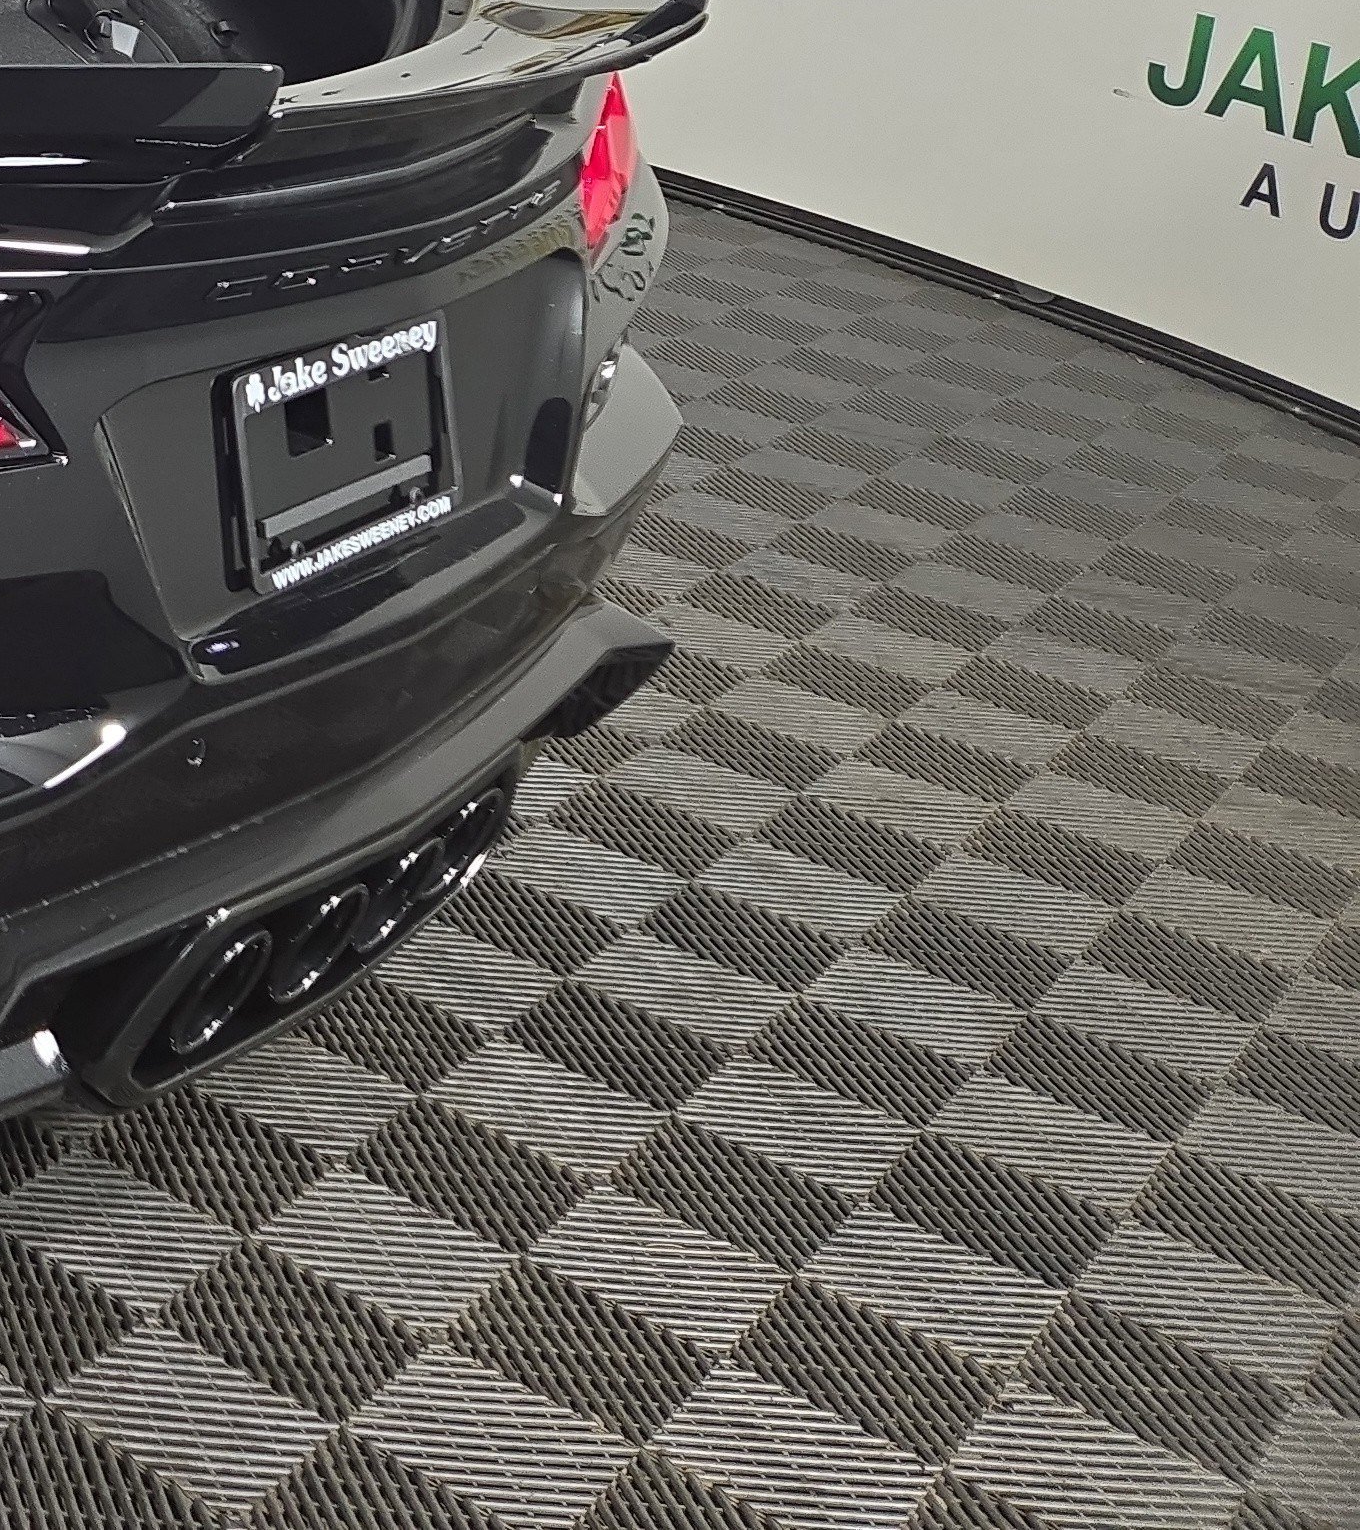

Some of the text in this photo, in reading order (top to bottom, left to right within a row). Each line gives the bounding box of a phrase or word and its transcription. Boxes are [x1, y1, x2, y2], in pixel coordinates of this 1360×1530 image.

[267, 320, 437, 402] Jake Sweeney
[271, 495, 452, 590] WWW.JAKESWEENEY.COM
